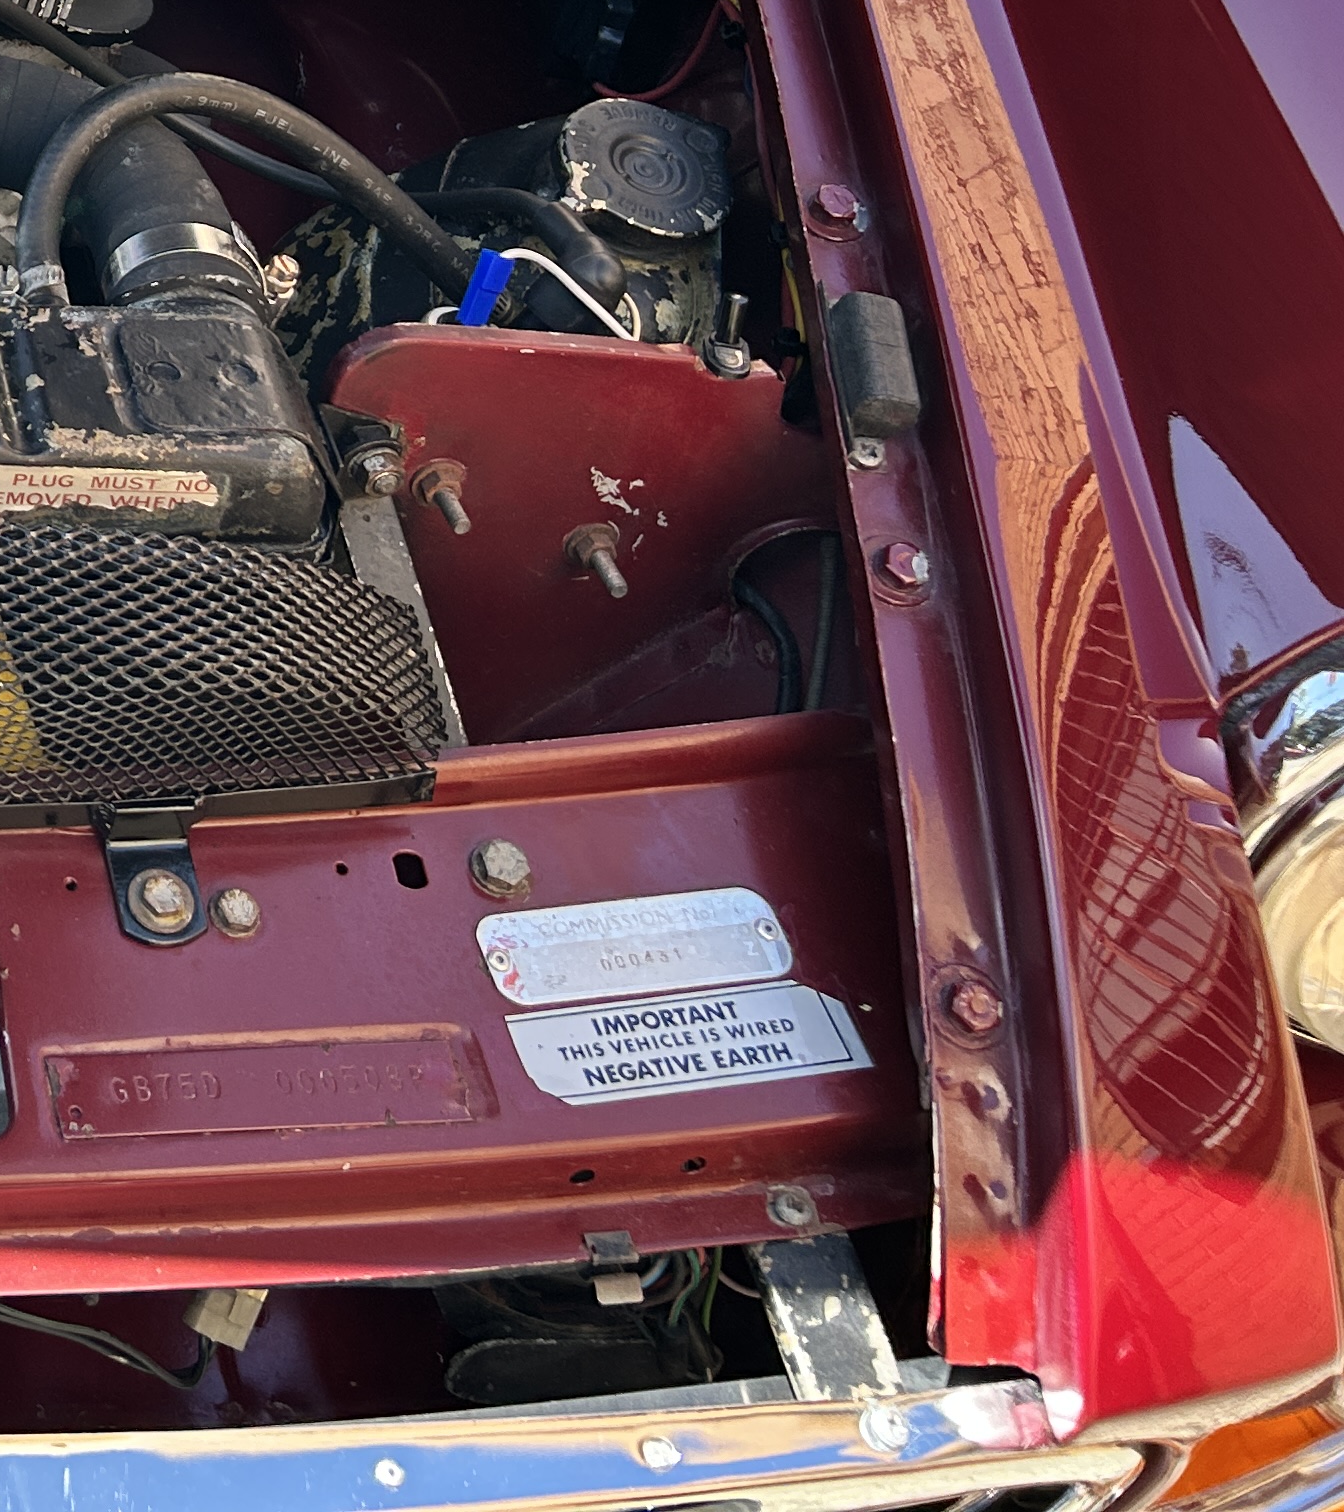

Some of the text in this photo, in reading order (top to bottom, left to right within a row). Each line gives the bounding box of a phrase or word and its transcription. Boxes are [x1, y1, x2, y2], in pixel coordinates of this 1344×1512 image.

[254, 108, 299, 137] FUEL
[311, 143, 352, 171] LINE
[12, 473, 75, 488] PLUG
[90, 476, 162, 490] MUST
[176, 479, 211, 493] NO
[110, 494, 185, 510] WHEN
[538, 909, 673, 937] COMMISSION
[590, 1000, 739, 1037] IMPORTANT
[557, 1017, 795, 1062] THIS VEHICLE IS WIRED
[582, 1041, 794, 1088] NEGATIVE EARTH
[110, 1070, 223, 1104] GB75D
